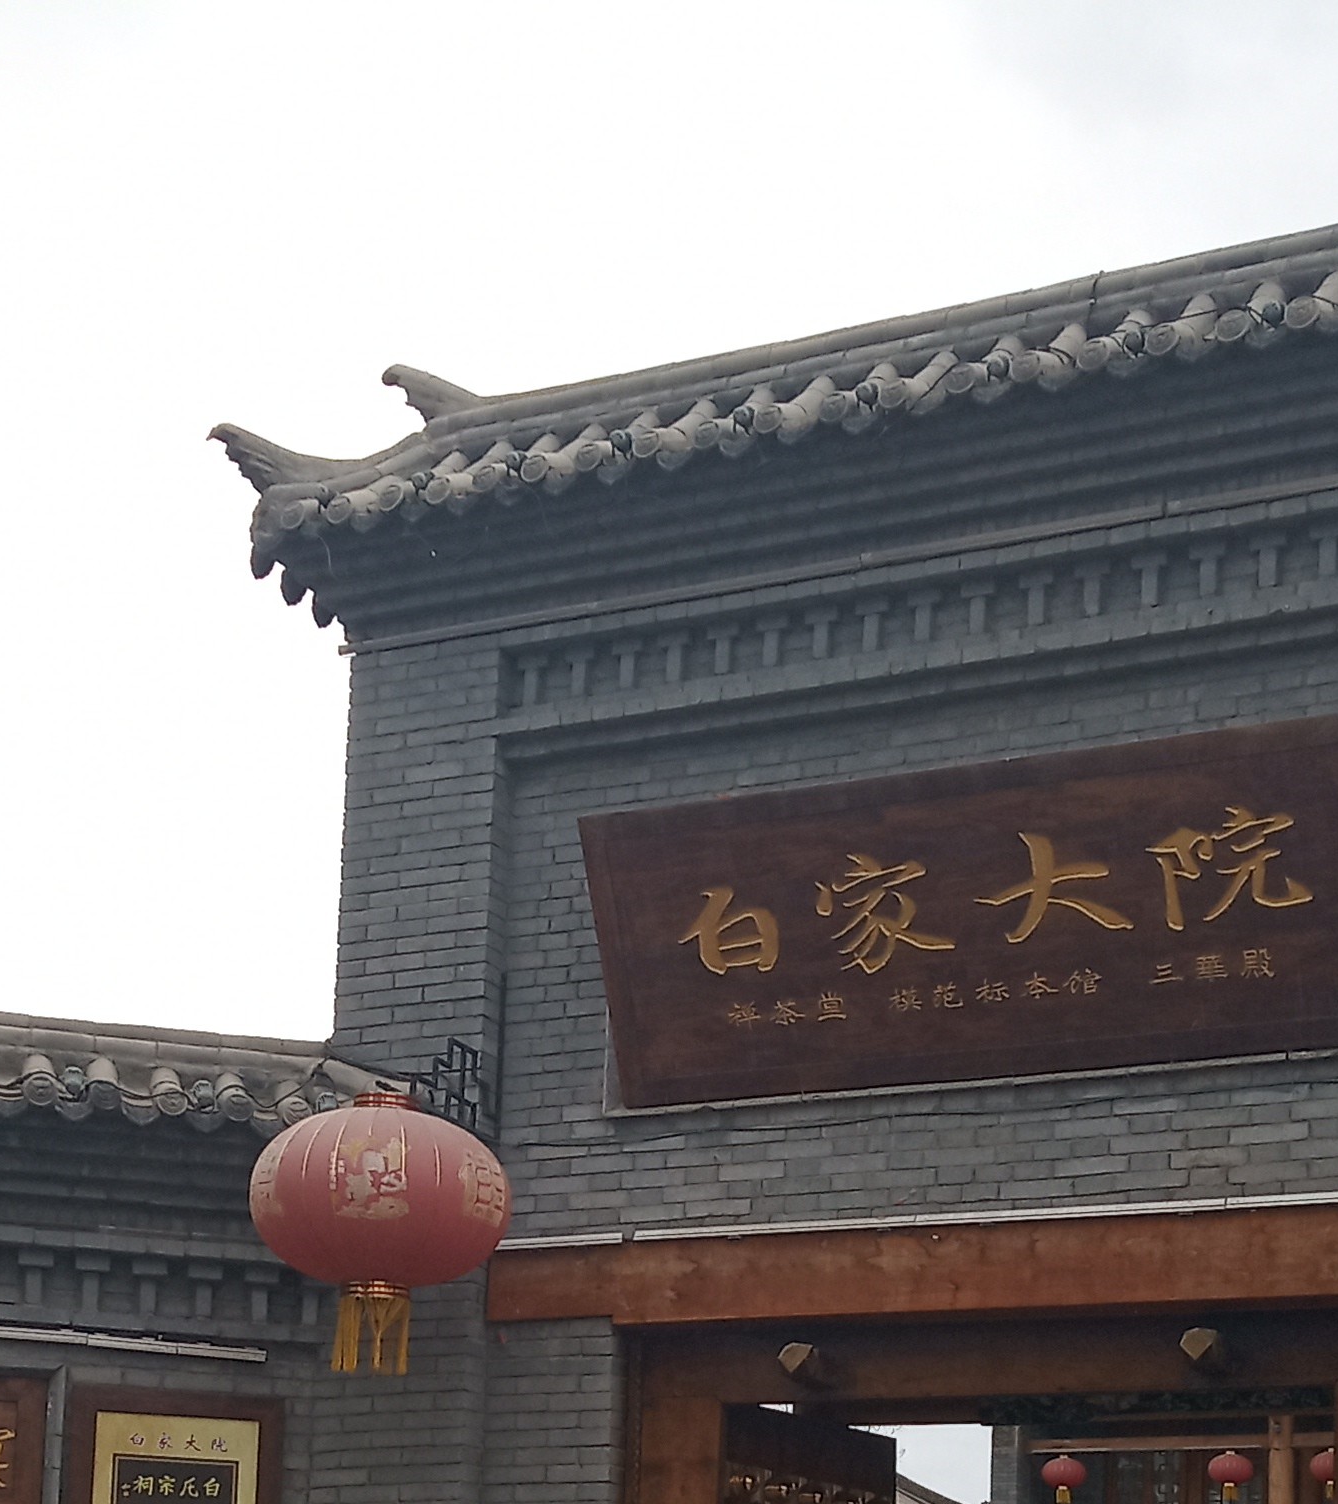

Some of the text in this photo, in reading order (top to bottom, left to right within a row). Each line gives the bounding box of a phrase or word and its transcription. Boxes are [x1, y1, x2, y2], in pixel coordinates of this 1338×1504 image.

[679, 806, 1313, 975] 白家大院
[129, 1432, 228, 1453] 白家大院
